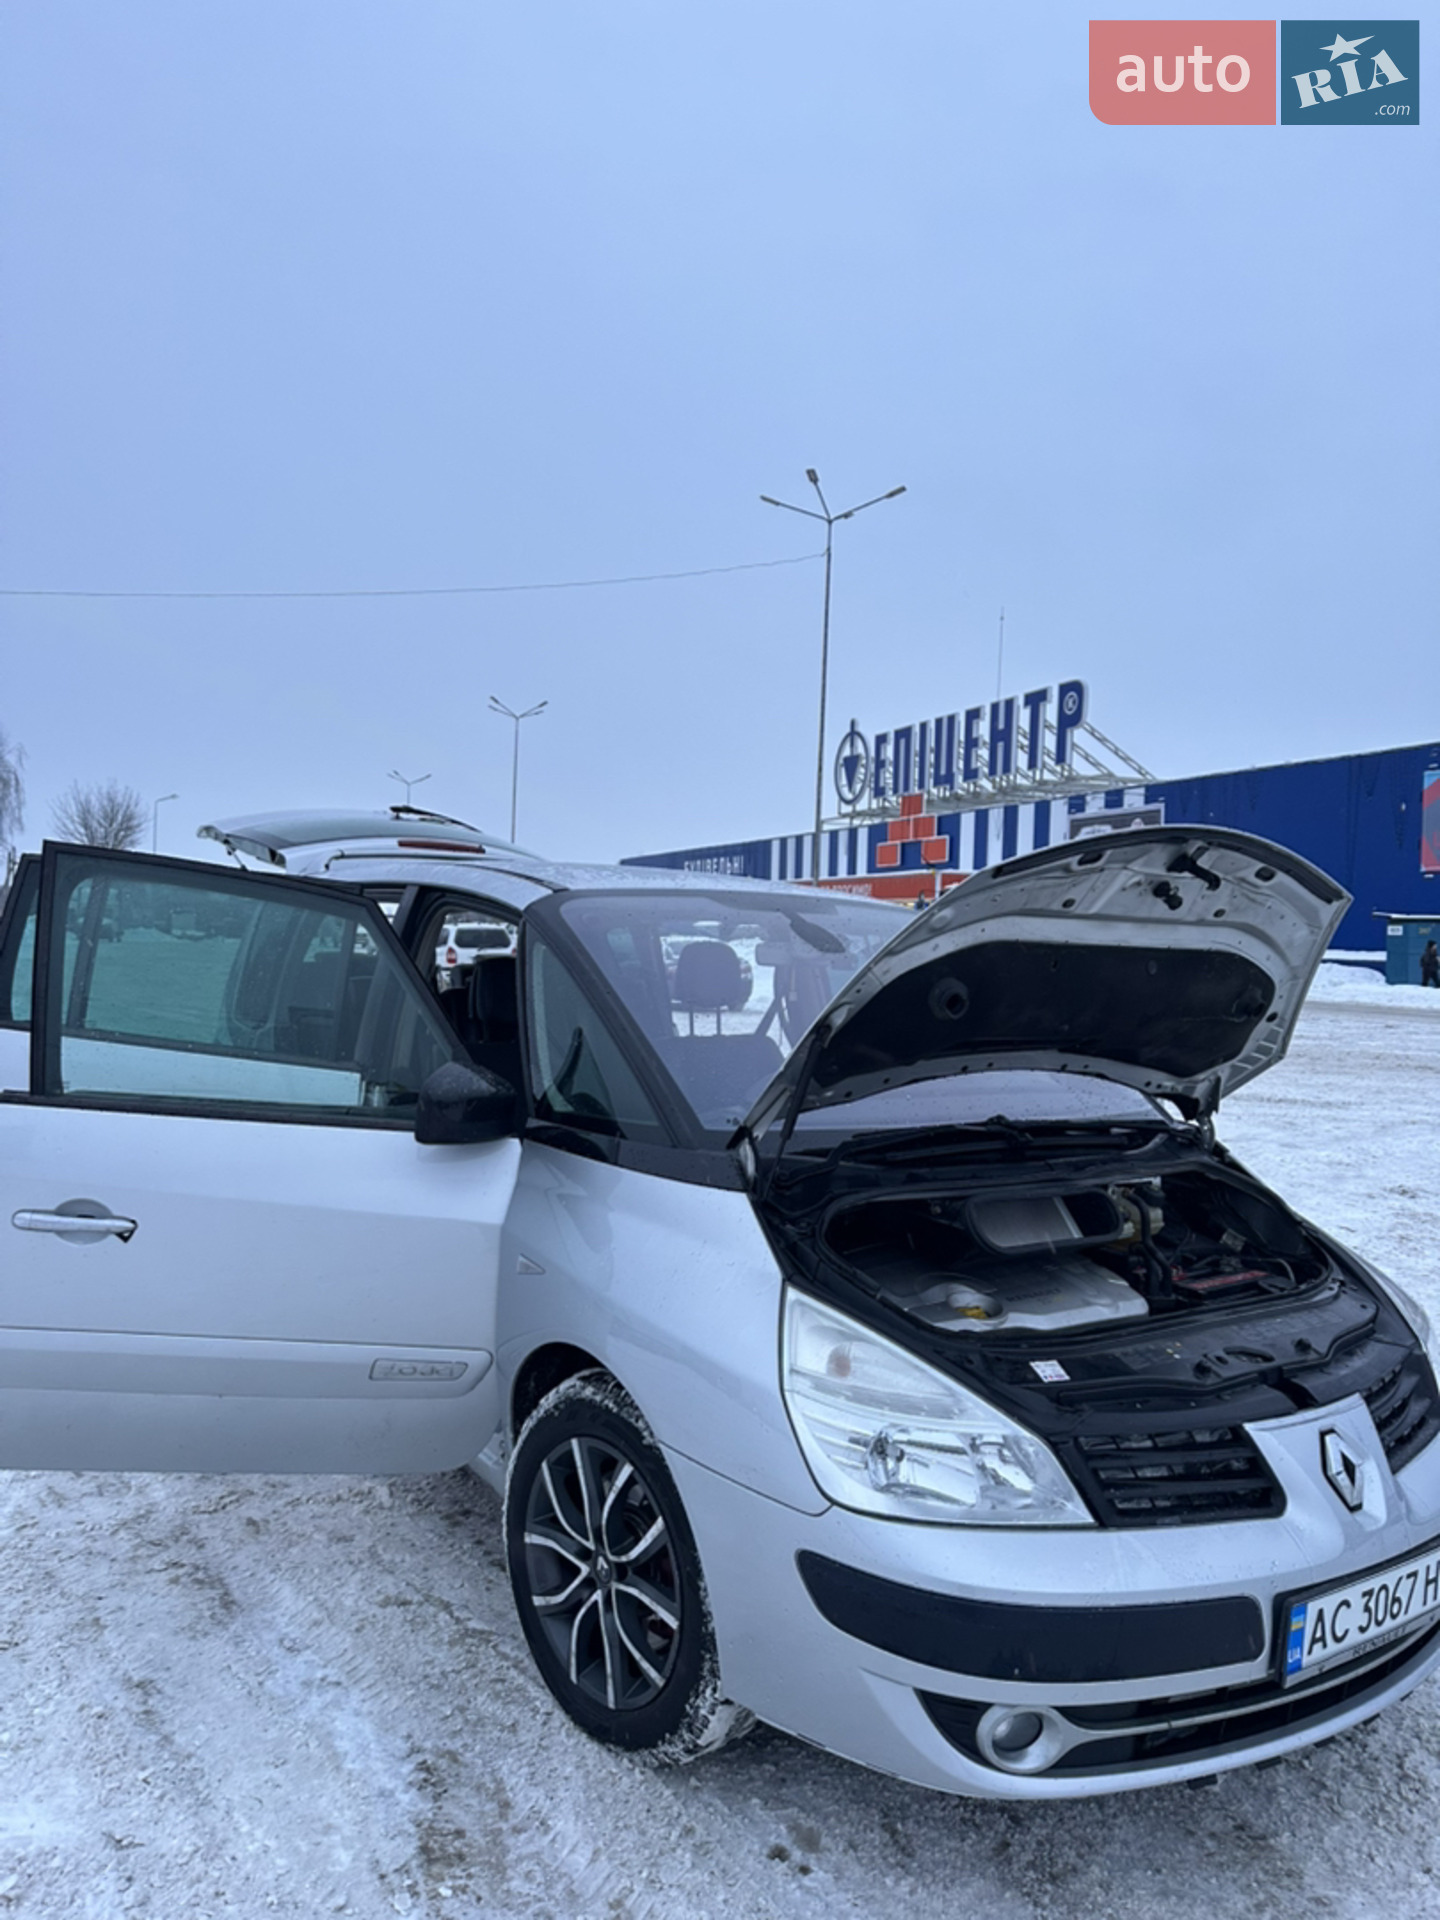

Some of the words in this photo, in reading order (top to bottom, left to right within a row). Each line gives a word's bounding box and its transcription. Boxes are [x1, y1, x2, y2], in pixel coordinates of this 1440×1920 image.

[873, 679, 1087, 799] ЕПІЦЕНТР
[1307, 1598, 1351, 1656] AC
[1357, 1570, 1419, 1634] 3067
